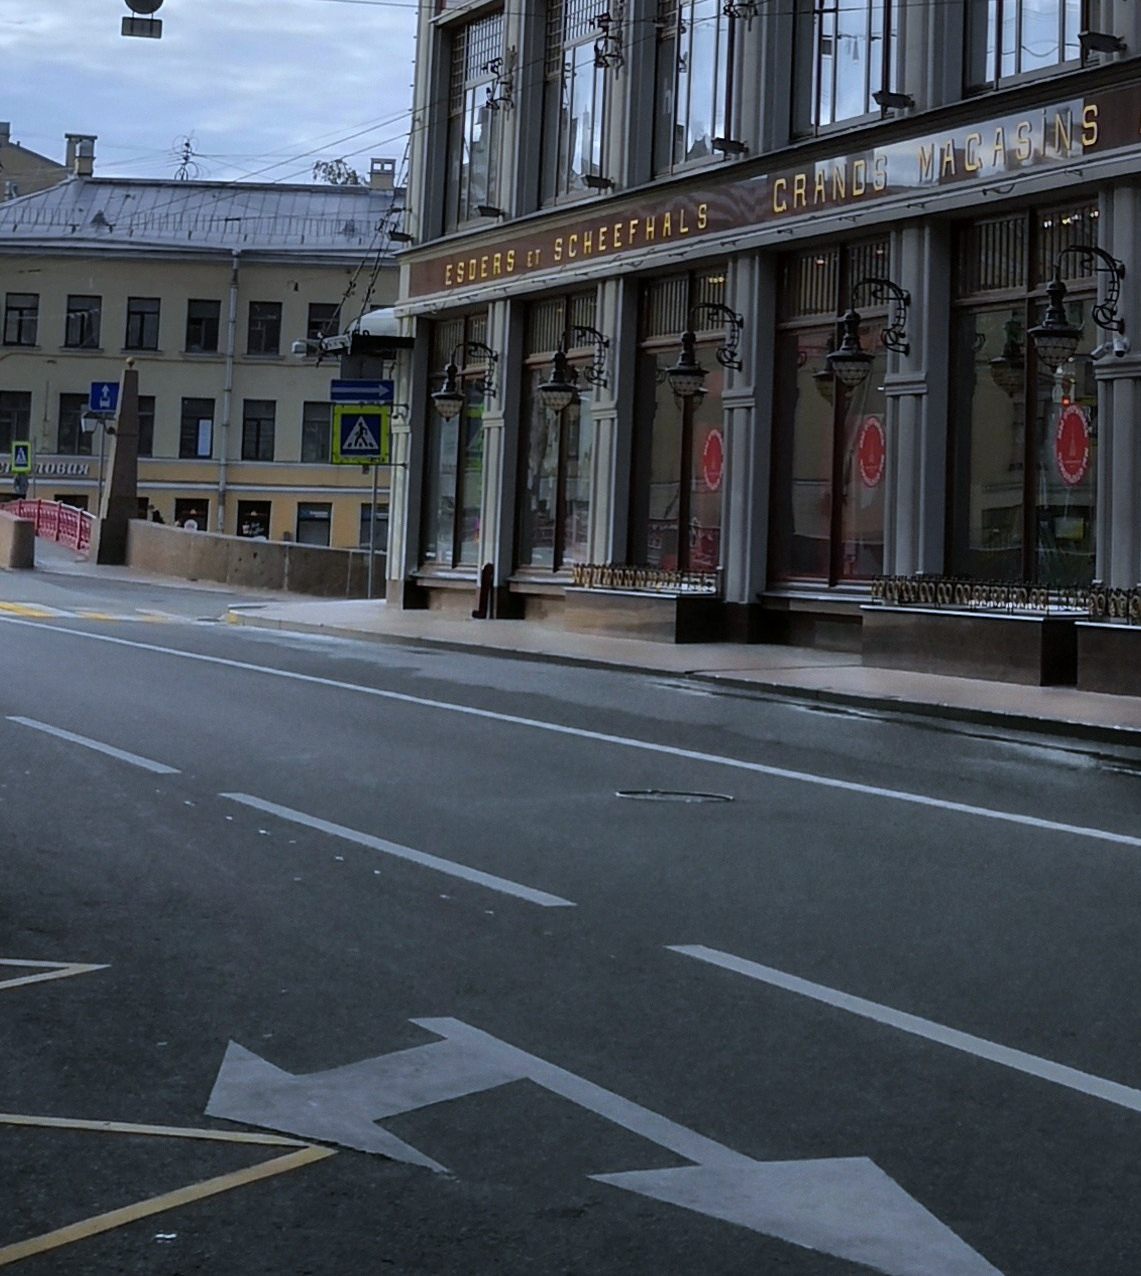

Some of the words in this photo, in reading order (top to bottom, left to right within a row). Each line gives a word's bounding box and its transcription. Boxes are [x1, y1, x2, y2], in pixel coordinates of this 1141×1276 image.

[445, 249, 515, 285] ESDERS
[527, 249, 541, 268] ET
[554, 203, 708, 261] SCHEEFHALS
[773, 153, 888, 213] GRANDS
[0, 461, 89, 475] ловая
